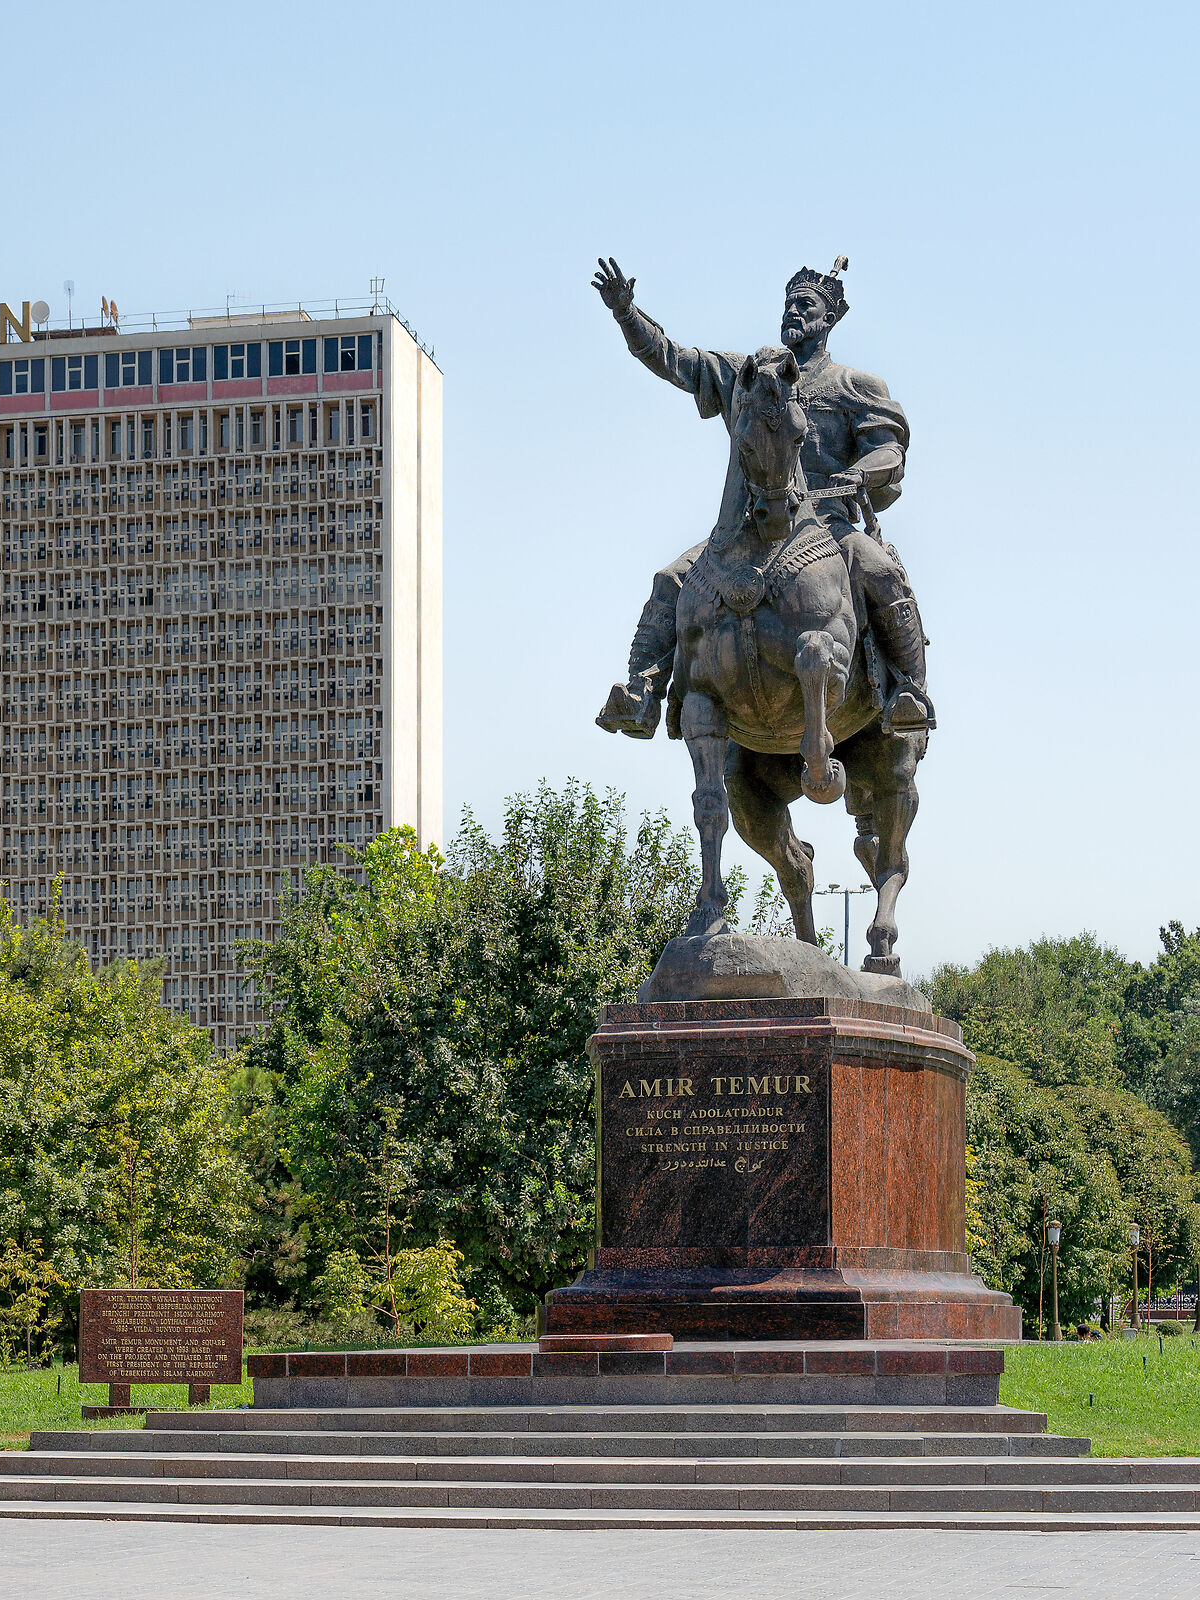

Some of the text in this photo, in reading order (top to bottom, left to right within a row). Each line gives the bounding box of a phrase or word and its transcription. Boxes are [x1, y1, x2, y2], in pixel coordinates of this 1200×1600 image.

[619, 1076, 812, 1098] AMIR TEMUR
[647, 1108, 783, 1119] KUCH ADOLATDADUR
[626, 1124, 805, 1137] СИЛА В СПРАВЕДЛИВОСТИ
[641, 1141, 788, 1153] STRENGTH IN JUSTICE
